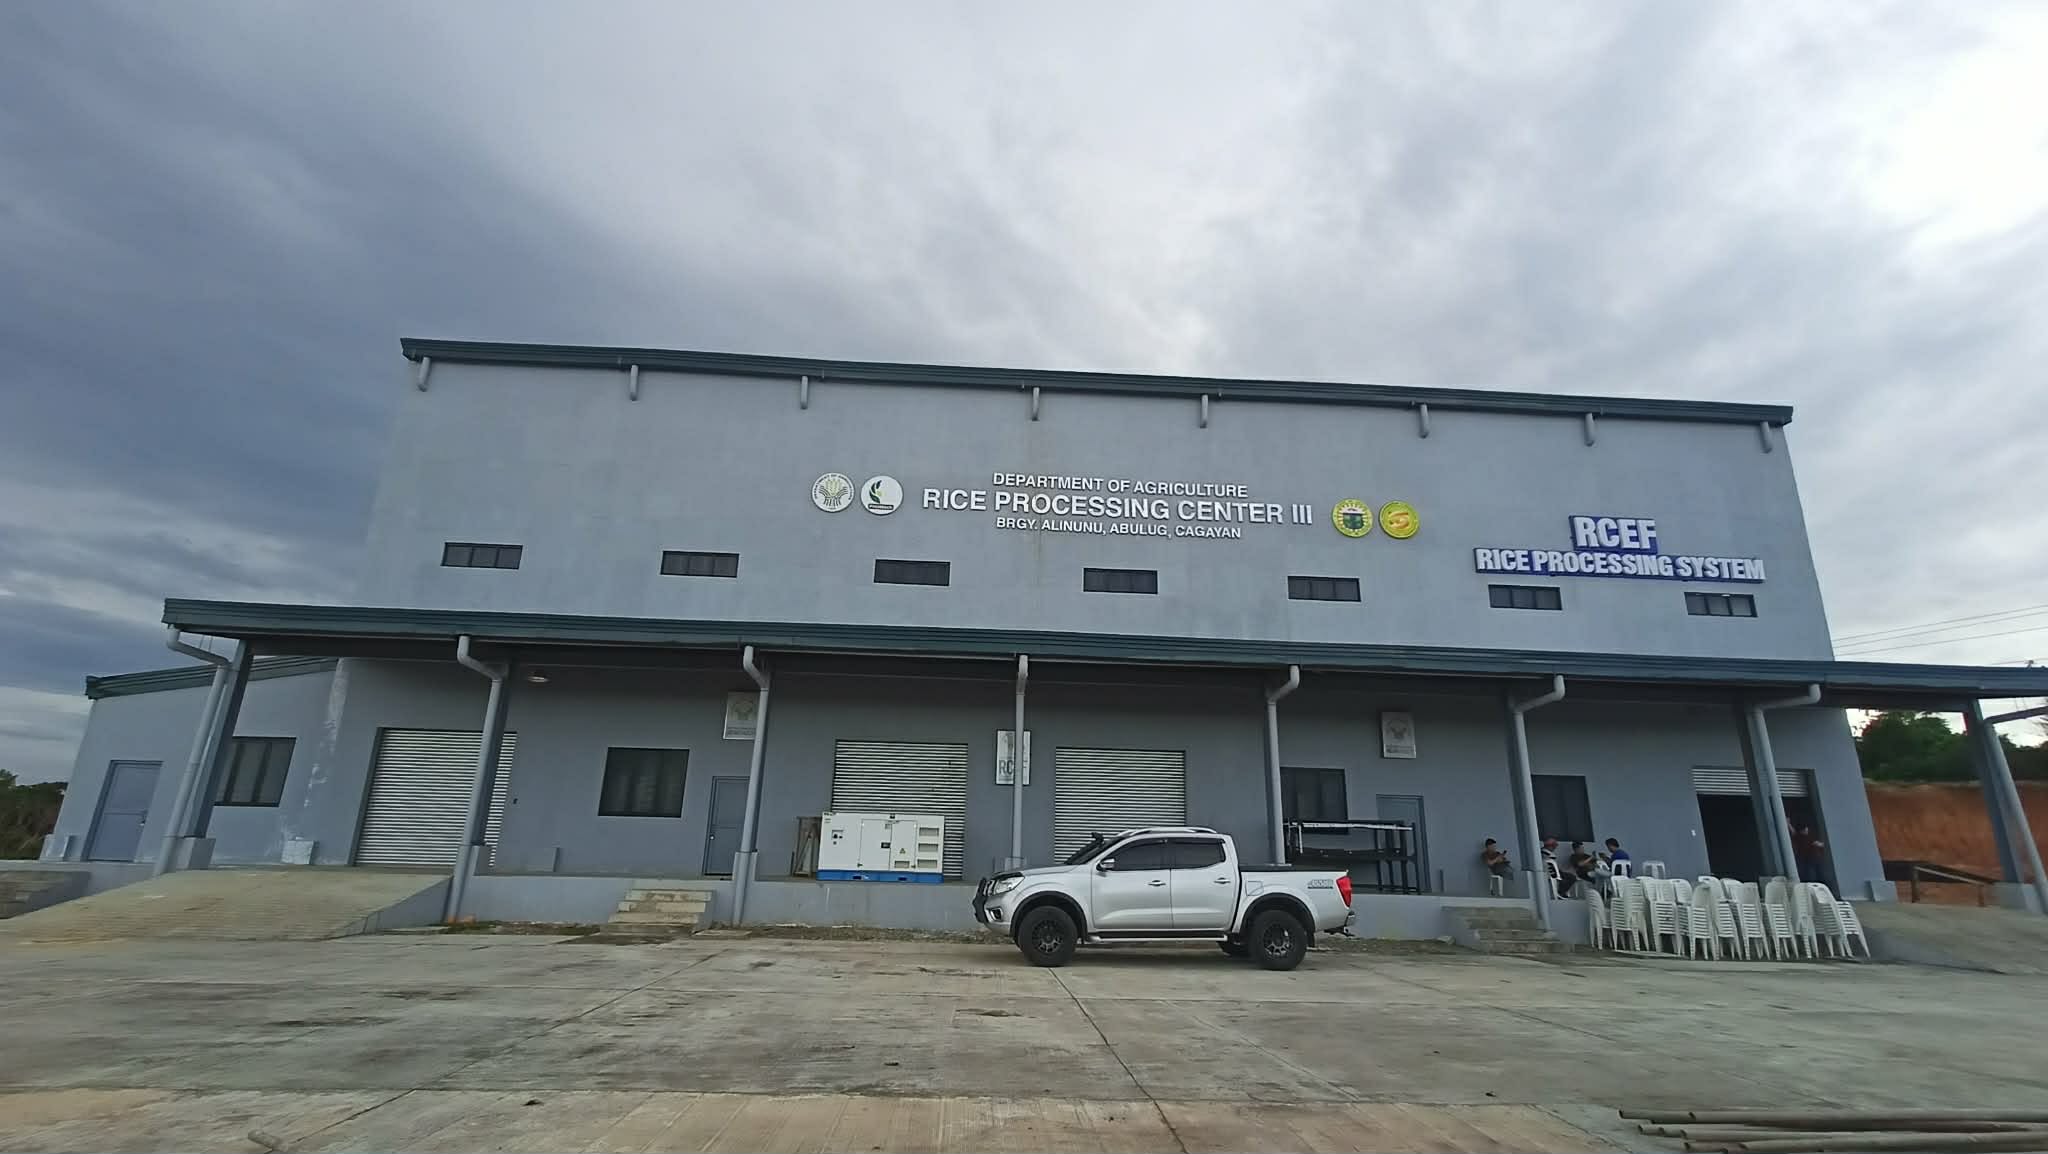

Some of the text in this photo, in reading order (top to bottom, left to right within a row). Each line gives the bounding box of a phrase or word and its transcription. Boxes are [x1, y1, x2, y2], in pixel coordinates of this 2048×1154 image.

[993, 472, 1249, 498] DEPARTMENT OF AGRICULTURE
[923, 488, 1313, 525] RICE PROCESSING CENTER III
[996, 517, 1241, 539] BRGY. ALINUNU, ABULUG, CAGAYAN
[1573, 516, 1658, 550] RCEF
[1476, 548, 1767, 580] RICE PROCESSING SYSTEM
